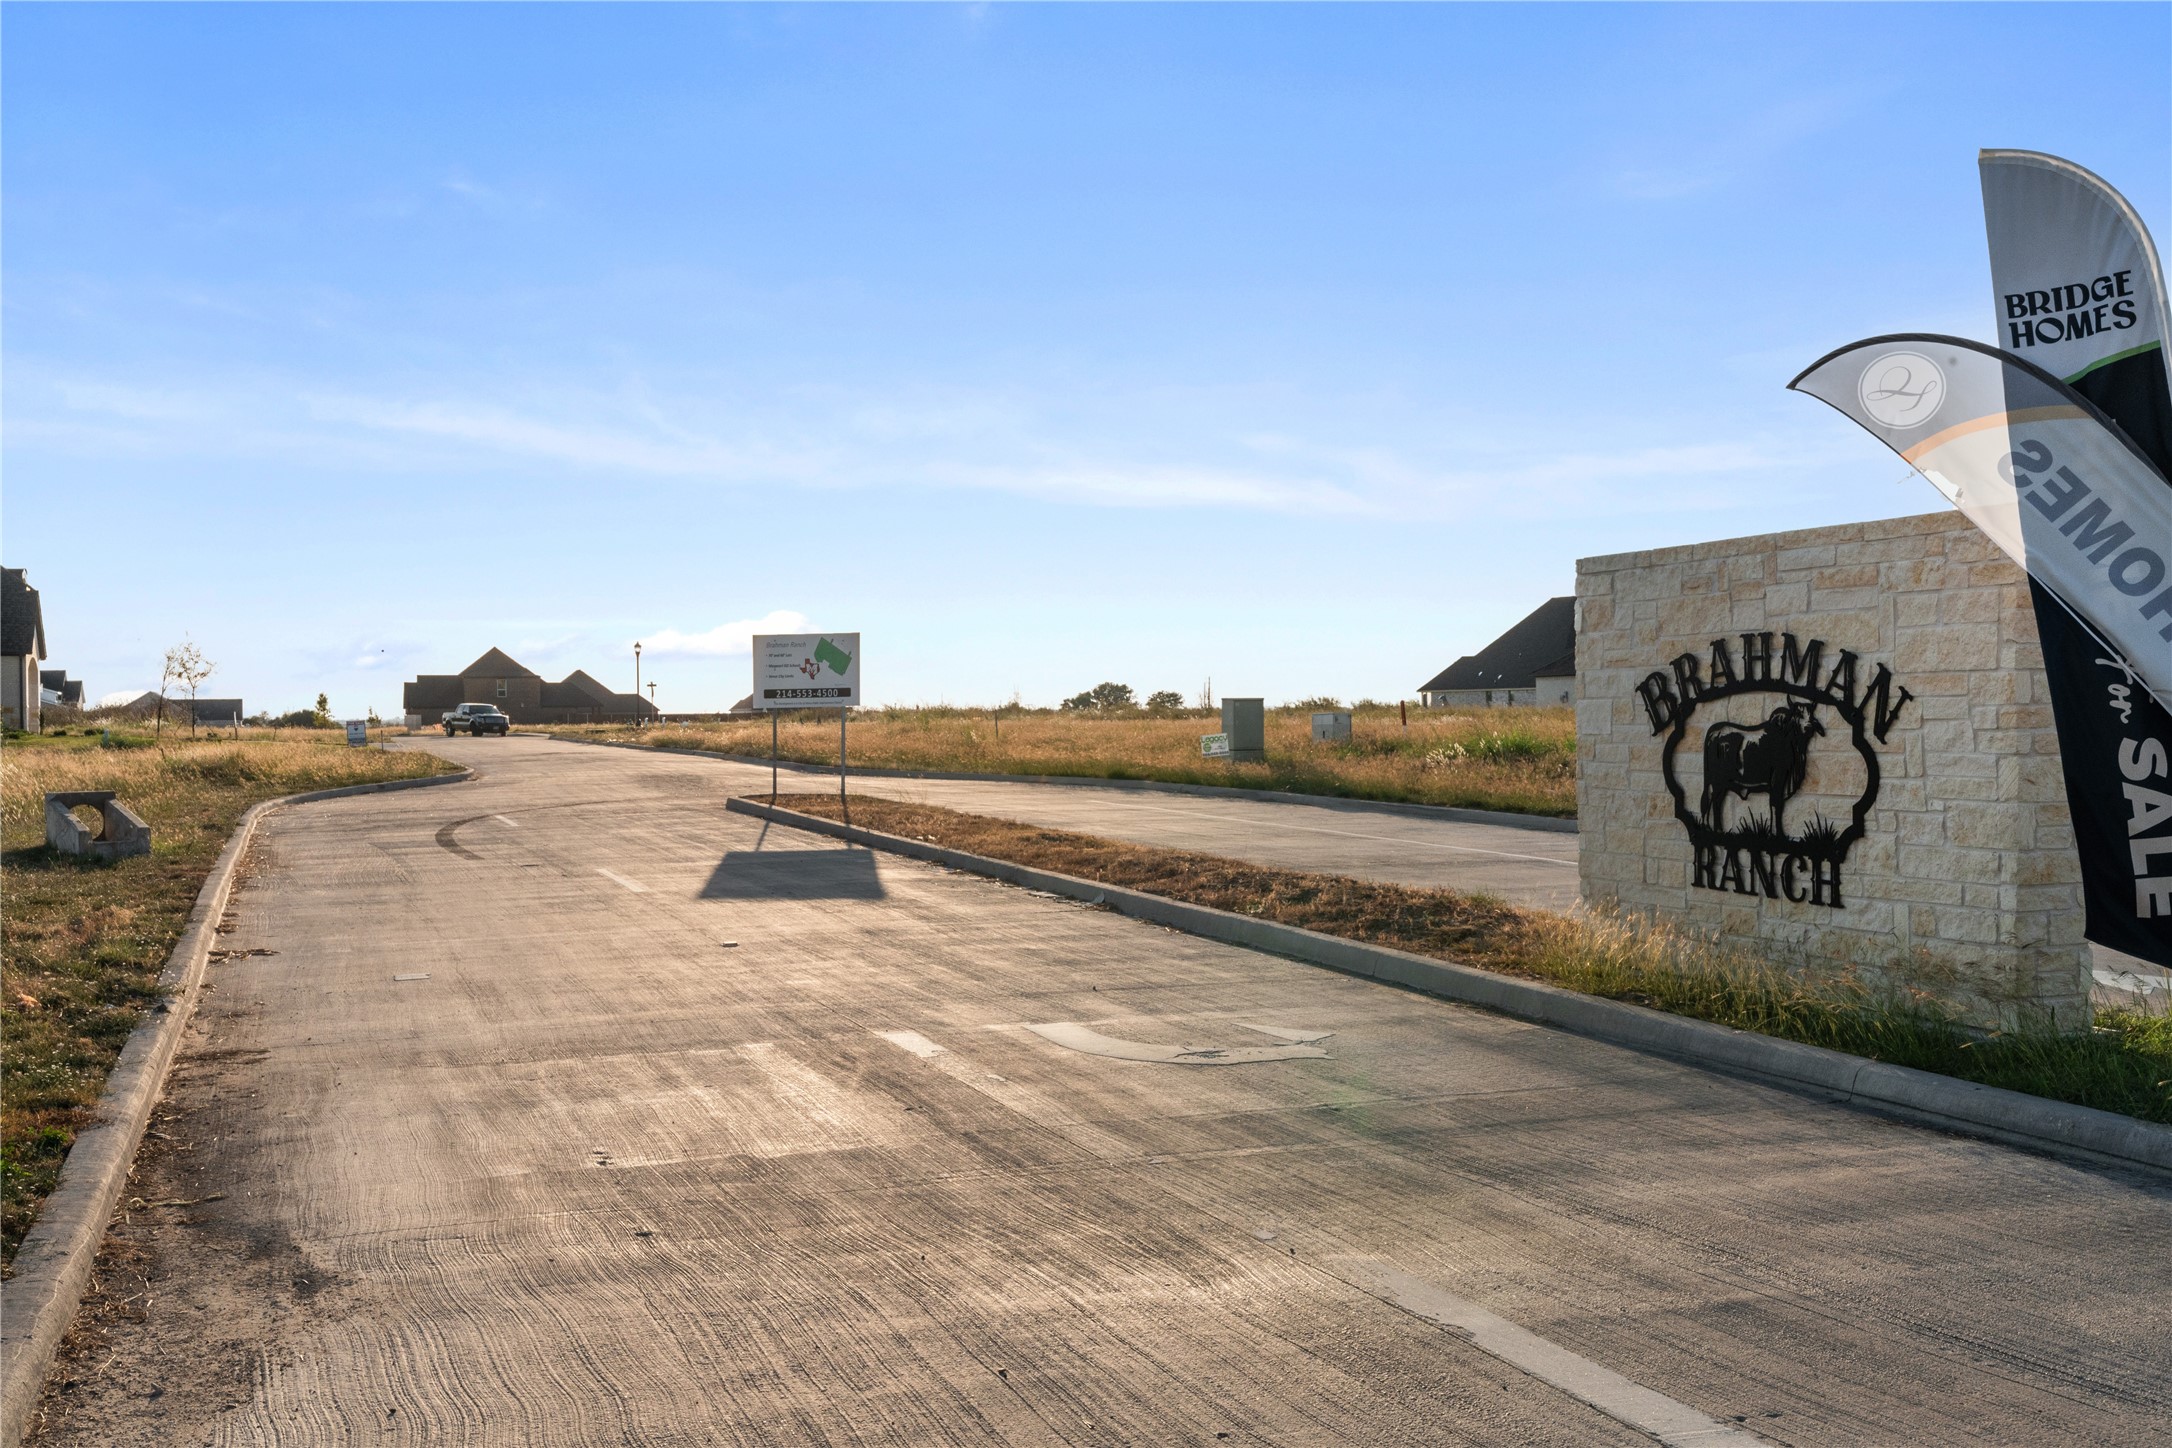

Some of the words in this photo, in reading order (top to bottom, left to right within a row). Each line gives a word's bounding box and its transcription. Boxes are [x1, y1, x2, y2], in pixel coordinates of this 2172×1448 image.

[2004, 270, 2134, 319] BRIDGE
[2008, 300, 2137, 349] HOMES
[776, 688, 839, 698] 214-553-4500
[1635, 632, 1914, 745] BRAHMAN
[2118, 737, 2172, 919] SALE
[1691, 846, 1846, 909] RANCH
